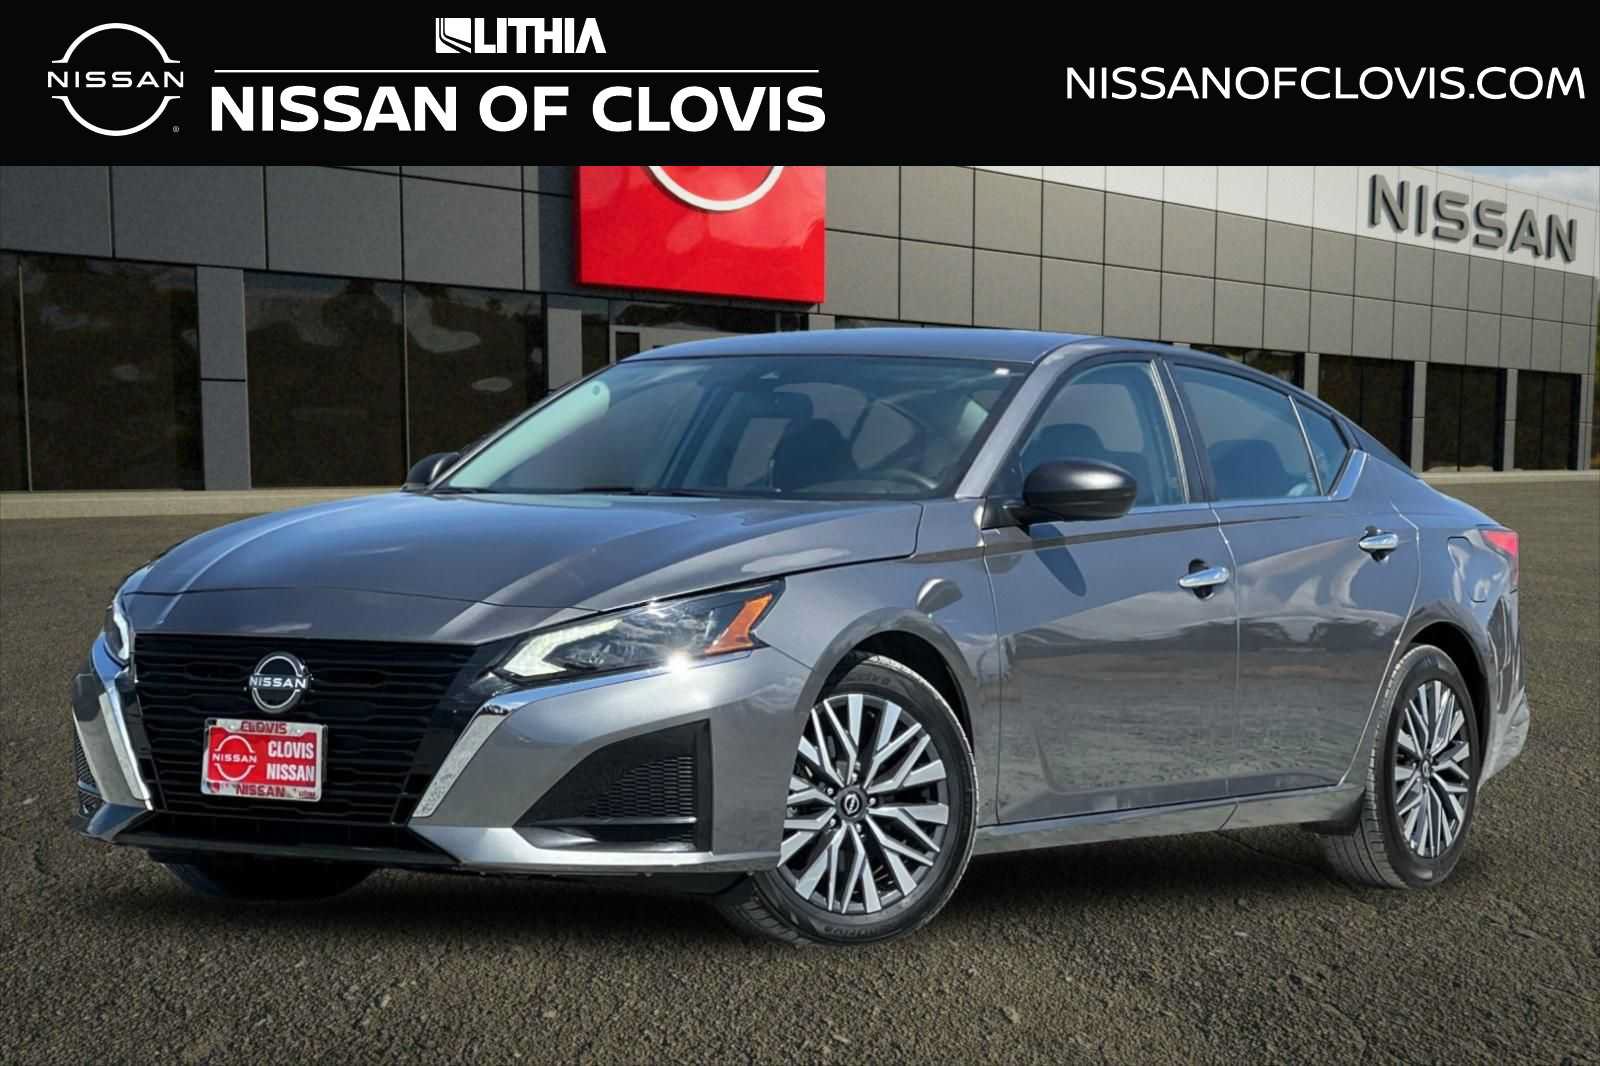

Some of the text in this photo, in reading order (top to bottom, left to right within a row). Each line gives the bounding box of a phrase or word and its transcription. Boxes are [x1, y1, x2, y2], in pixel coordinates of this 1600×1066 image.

[1368, 173, 1577, 264] NISSAN
[250, 676, 307, 689] NISSAN
[240, 720, 288, 735] CLOVIS
[267, 740, 314, 760] CLOVIS
[212, 752, 257, 764] NISSAN
[266, 763, 316, 783] NISSAN
[235, 784, 286, 798] NISSAN
